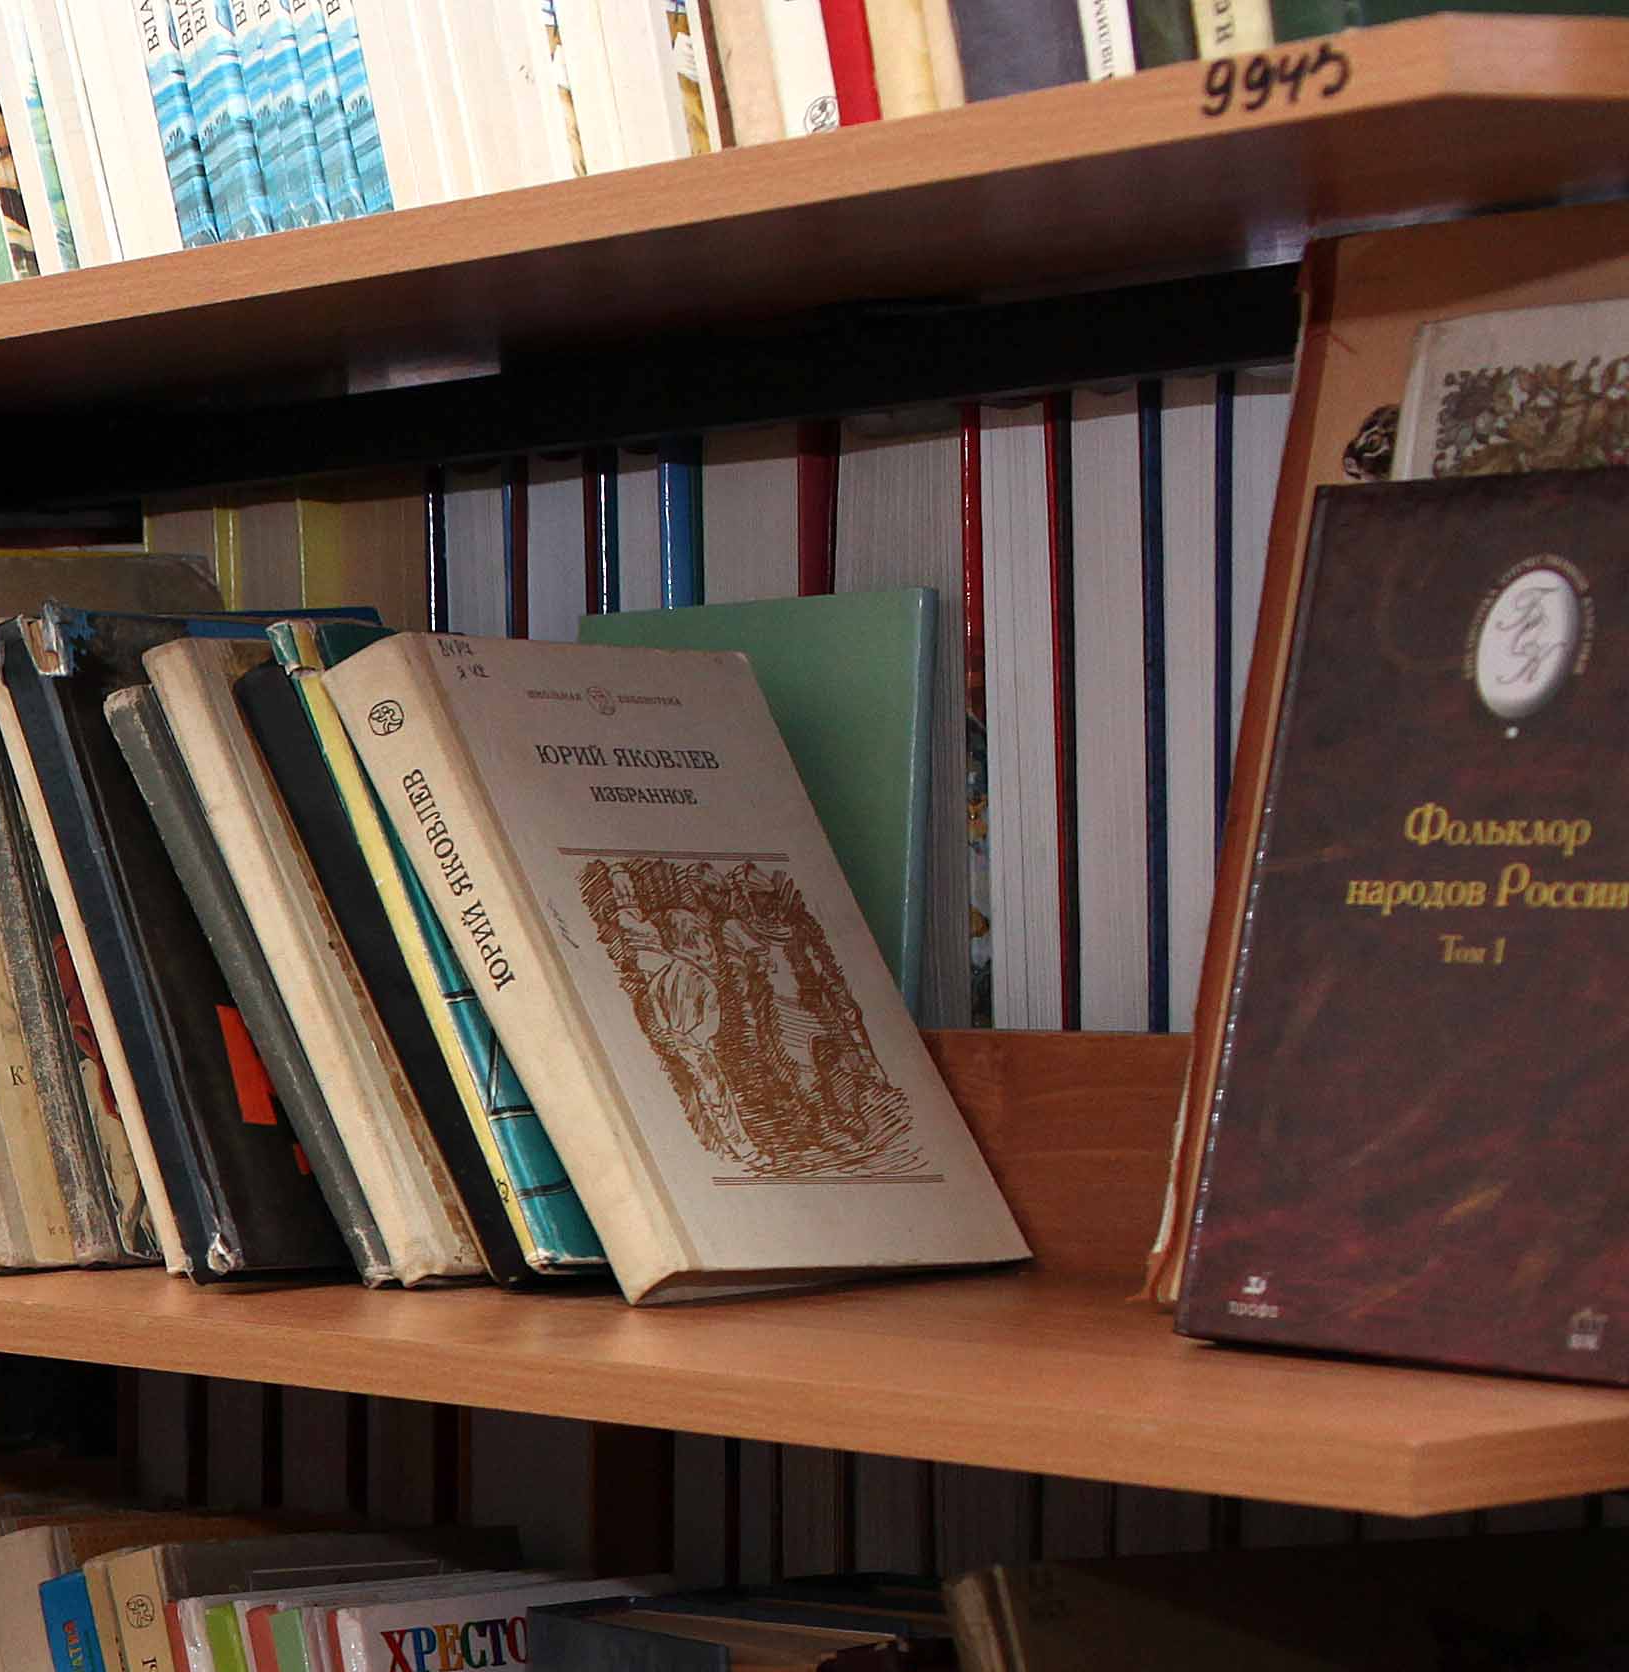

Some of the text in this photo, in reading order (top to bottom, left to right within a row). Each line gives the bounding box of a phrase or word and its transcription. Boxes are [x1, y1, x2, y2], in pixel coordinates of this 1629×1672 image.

[1200, 43, 1351, 117] 9945
[535, 744, 720, 770] ЮРИЙ ЯКОВЛЕВ
[589, 785, 698, 806] ИЗБРАННОЕ
[1404, 801, 1592, 858] Фольклор
[396, 767, 520, 991] ЮРИЙ ЯКОВЛЕВ
[1346, 878, 1488, 917] народов
[1439, 934, 1486, 964] Том
